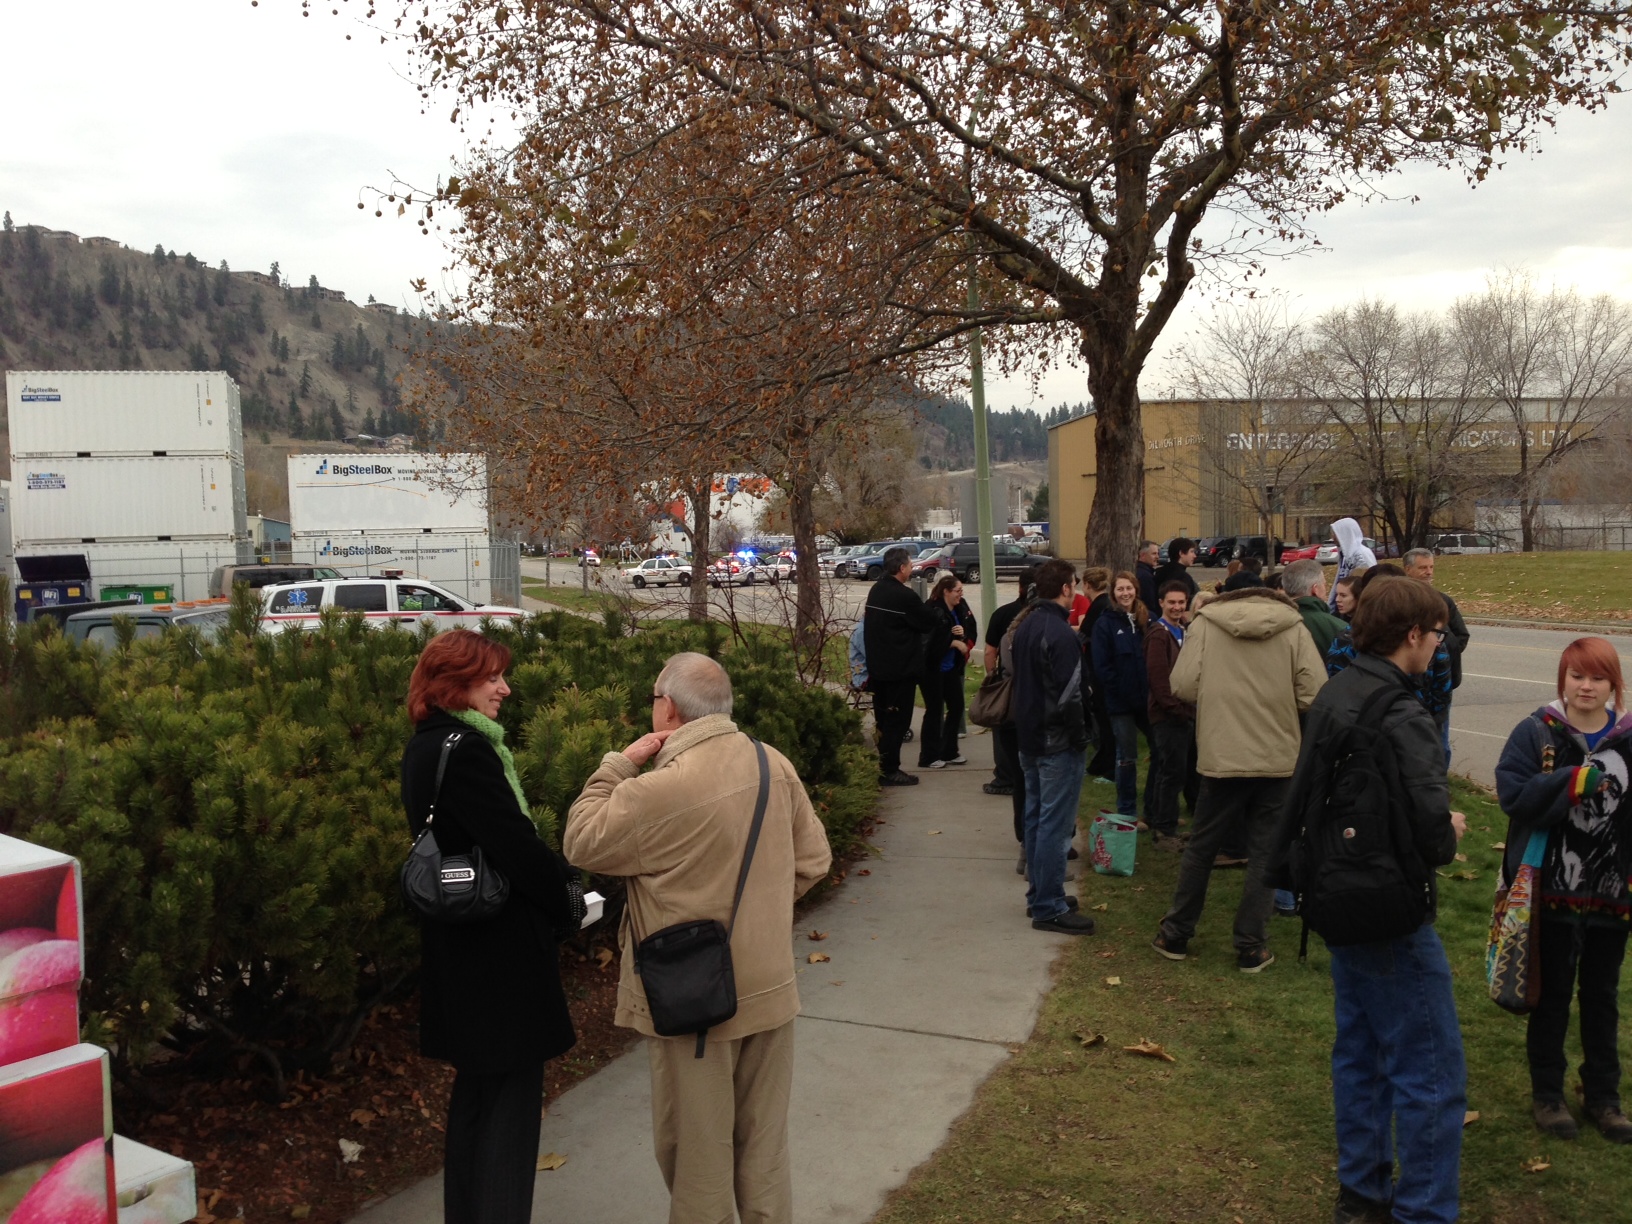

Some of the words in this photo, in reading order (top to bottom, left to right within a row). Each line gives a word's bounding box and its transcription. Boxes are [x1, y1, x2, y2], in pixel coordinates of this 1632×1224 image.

[1185, 434, 1206, 446] DRIVE
[1226, 432, 1341, 450] ENTERPRISE
[1417, 430, 1534, 448] FRICATORS
[332, 464, 393, 476] BigSteelBox
[332, 545, 393, 557] BigSteelBox
[444, 871, 469, 879] GUESS
